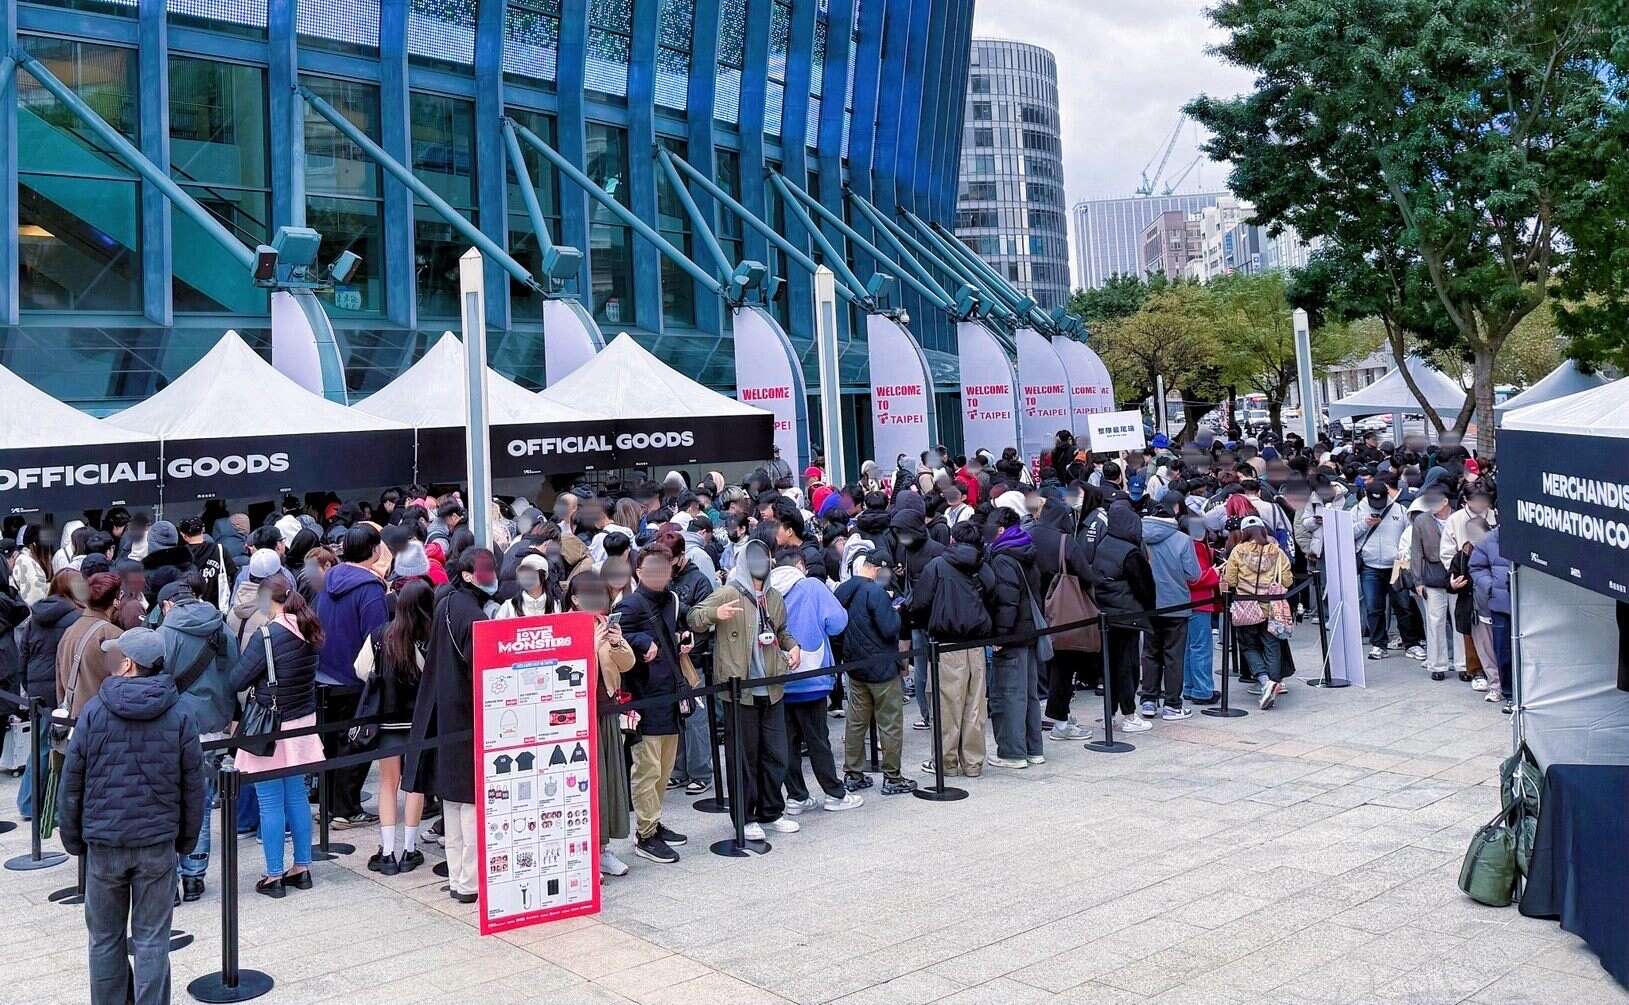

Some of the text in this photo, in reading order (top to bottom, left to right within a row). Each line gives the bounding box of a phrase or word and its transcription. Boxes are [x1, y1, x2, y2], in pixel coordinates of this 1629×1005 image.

[742, 387, 790, 400] WELCOME
[876, 385, 921, 397] WELCOME
[966, 385, 1009, 395] WELCOME
[1024, 385, 1065, 395] WELCOME
[1071, 386, 1096, 395] LCOME
[877, 400, 889, 410] TO
[967, 399, 978, 408] TO
[1025, 397, 1036, 406] TO
[980, 411, 1011, 420] TAIPEI
[1038, 409, 1067, 417] TAIPEI
[891, 415, 923, 424] TAIPEI
[774, 421, 791, 430] PEI
[507, 431, 695, 457] OFFICIAL GOODS
[0, 452, 290, 491] OFFICIAL GOODS
[1542, 472, 1629, 511] MERCHANDIS
[1517, 499, 1605, 543] INFORMATION
